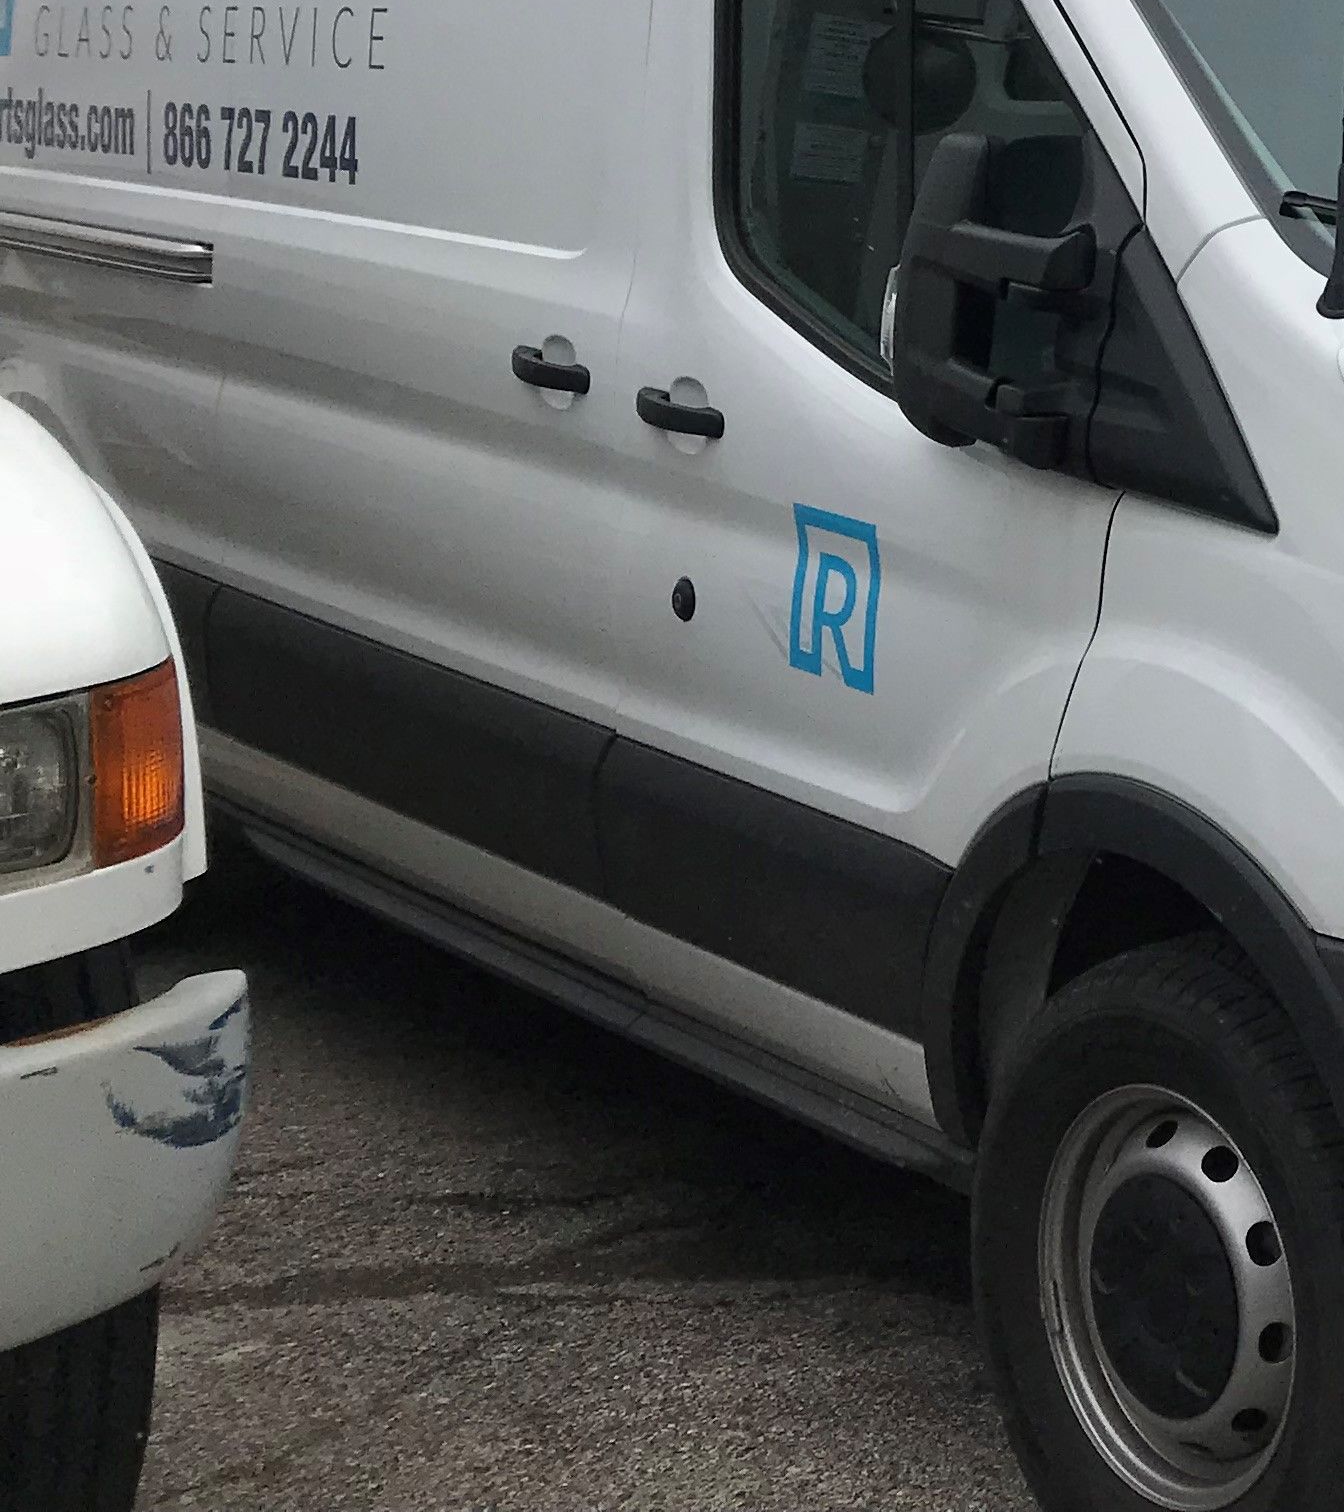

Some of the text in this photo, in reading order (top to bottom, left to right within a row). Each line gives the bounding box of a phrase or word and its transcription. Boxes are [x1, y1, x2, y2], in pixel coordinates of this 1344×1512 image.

[34, 4, 389, 70] GLASS & SERVICE
[163, 101, 212, 169] 866
[220, 106, 271, 175] 727
[281, 110, 359, 185] 2244
